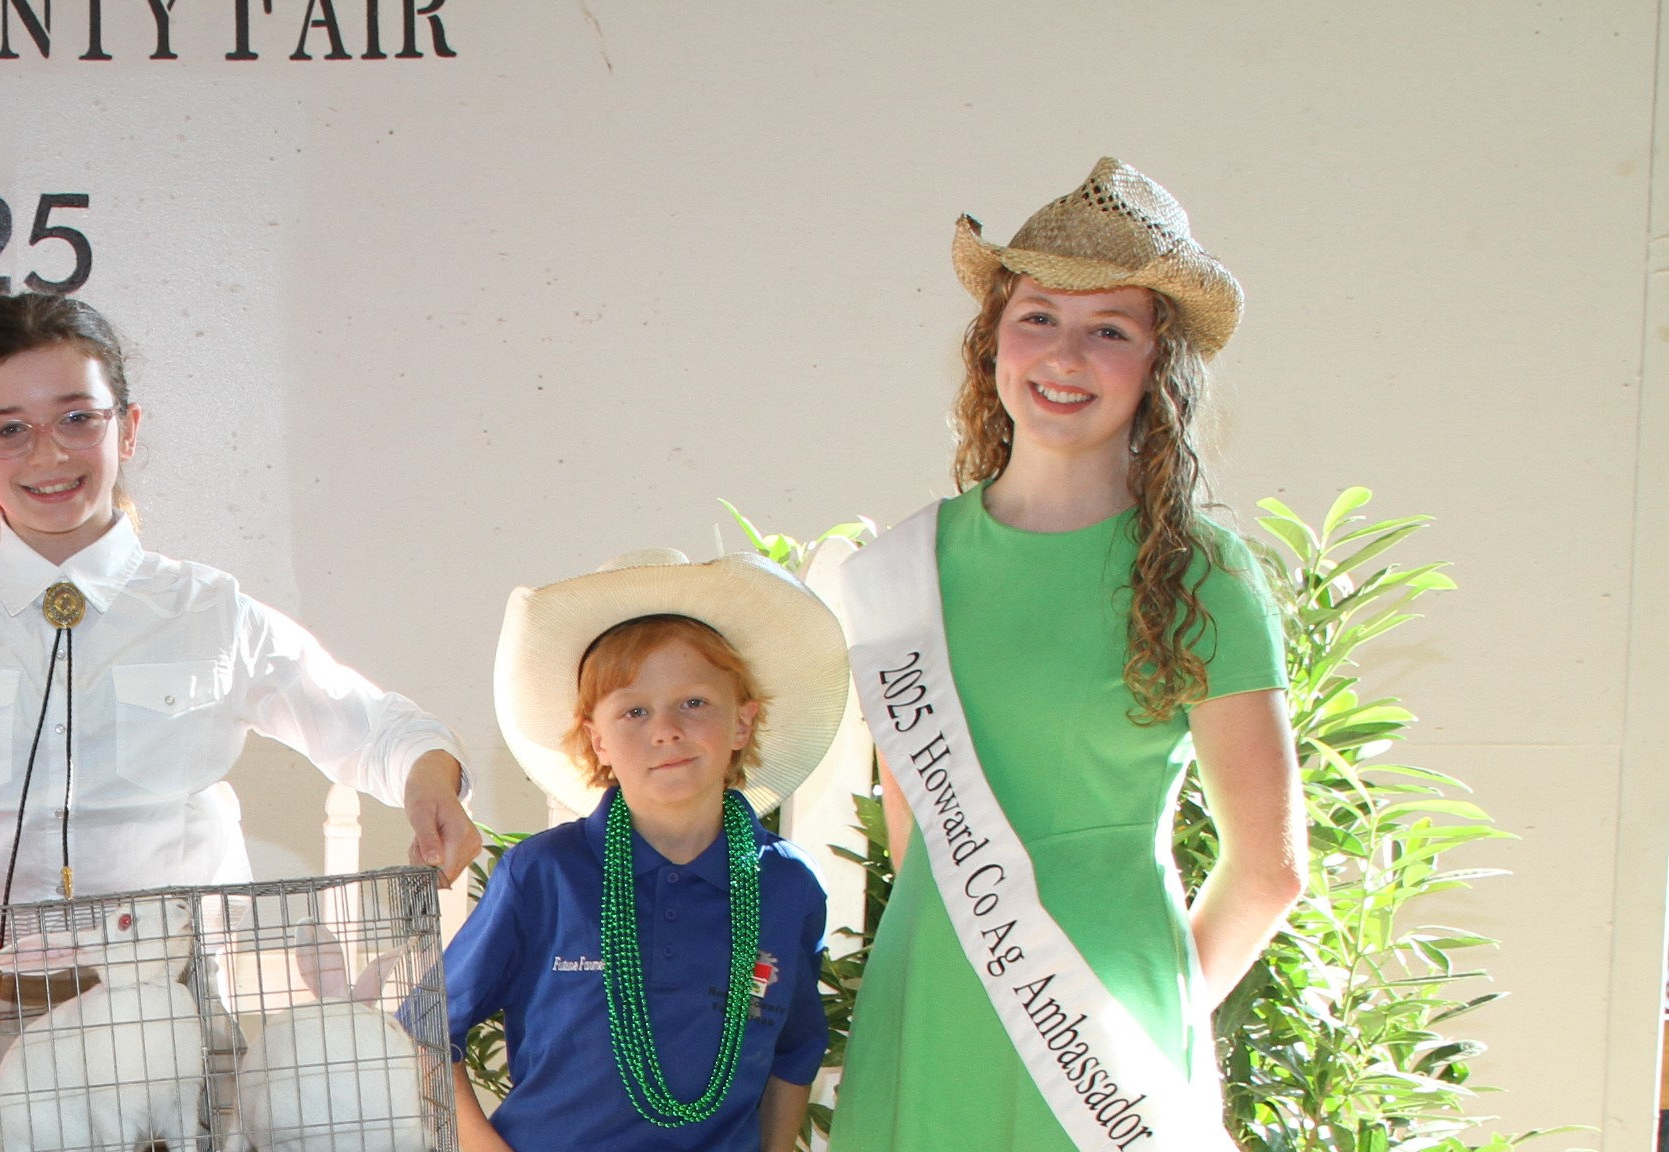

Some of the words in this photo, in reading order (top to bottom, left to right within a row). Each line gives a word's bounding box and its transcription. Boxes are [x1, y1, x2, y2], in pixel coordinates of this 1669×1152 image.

[879, 651, 934, 733] 2025
[910, 730, 991, 867] Howard
[964, 862, 1006, 917] Co
[981, 918, 1025, 978] Ag
[1013, 973, 1154, 1152] Ambassador
